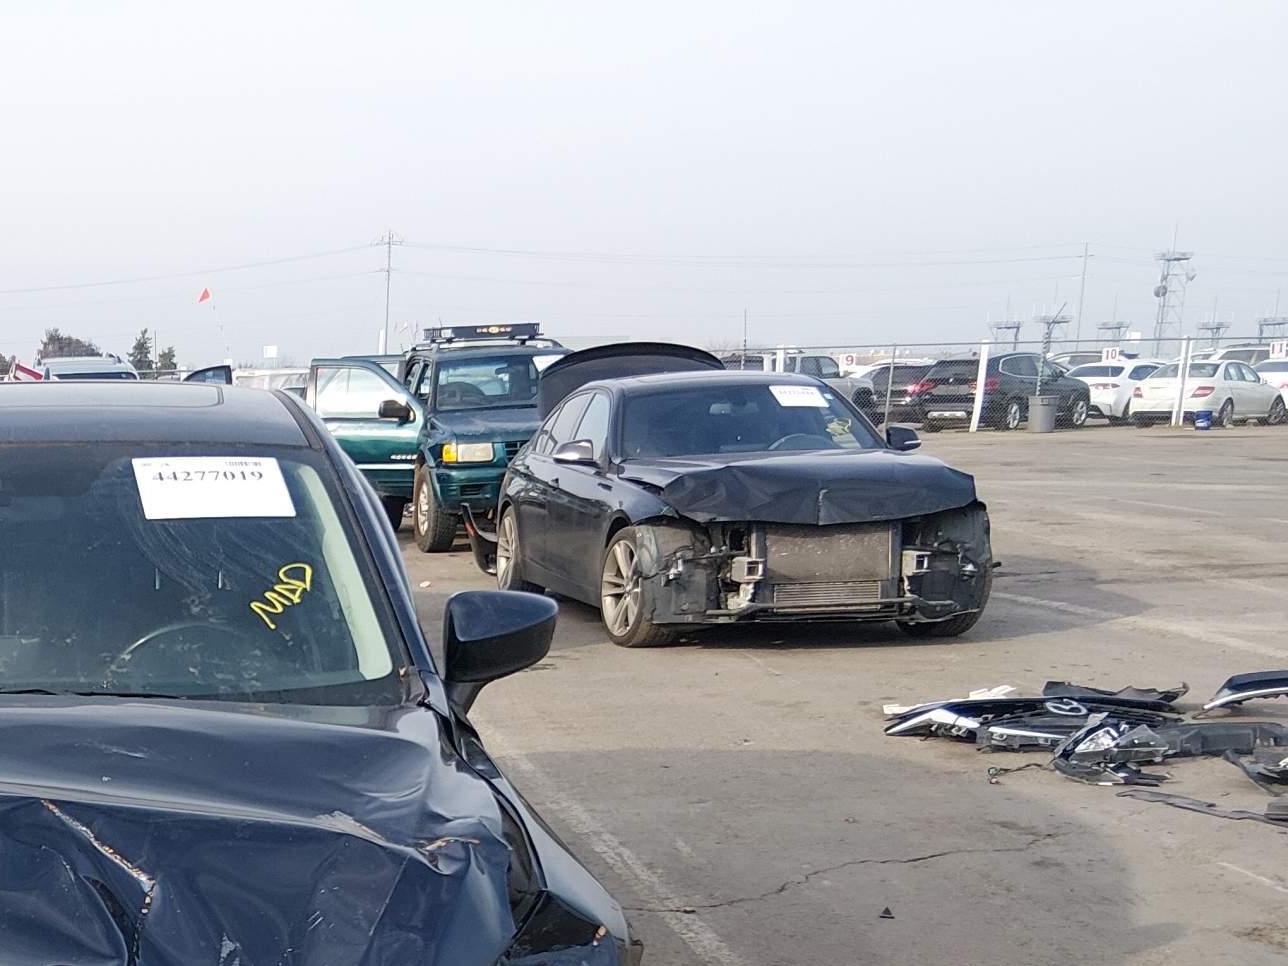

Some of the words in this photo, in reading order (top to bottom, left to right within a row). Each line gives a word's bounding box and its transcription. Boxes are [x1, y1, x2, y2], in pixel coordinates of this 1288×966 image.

[845, 354, 855, 366] 9
[1105, 348, 1118, 361] 10
[152, 470, 264, 482] 44277019
